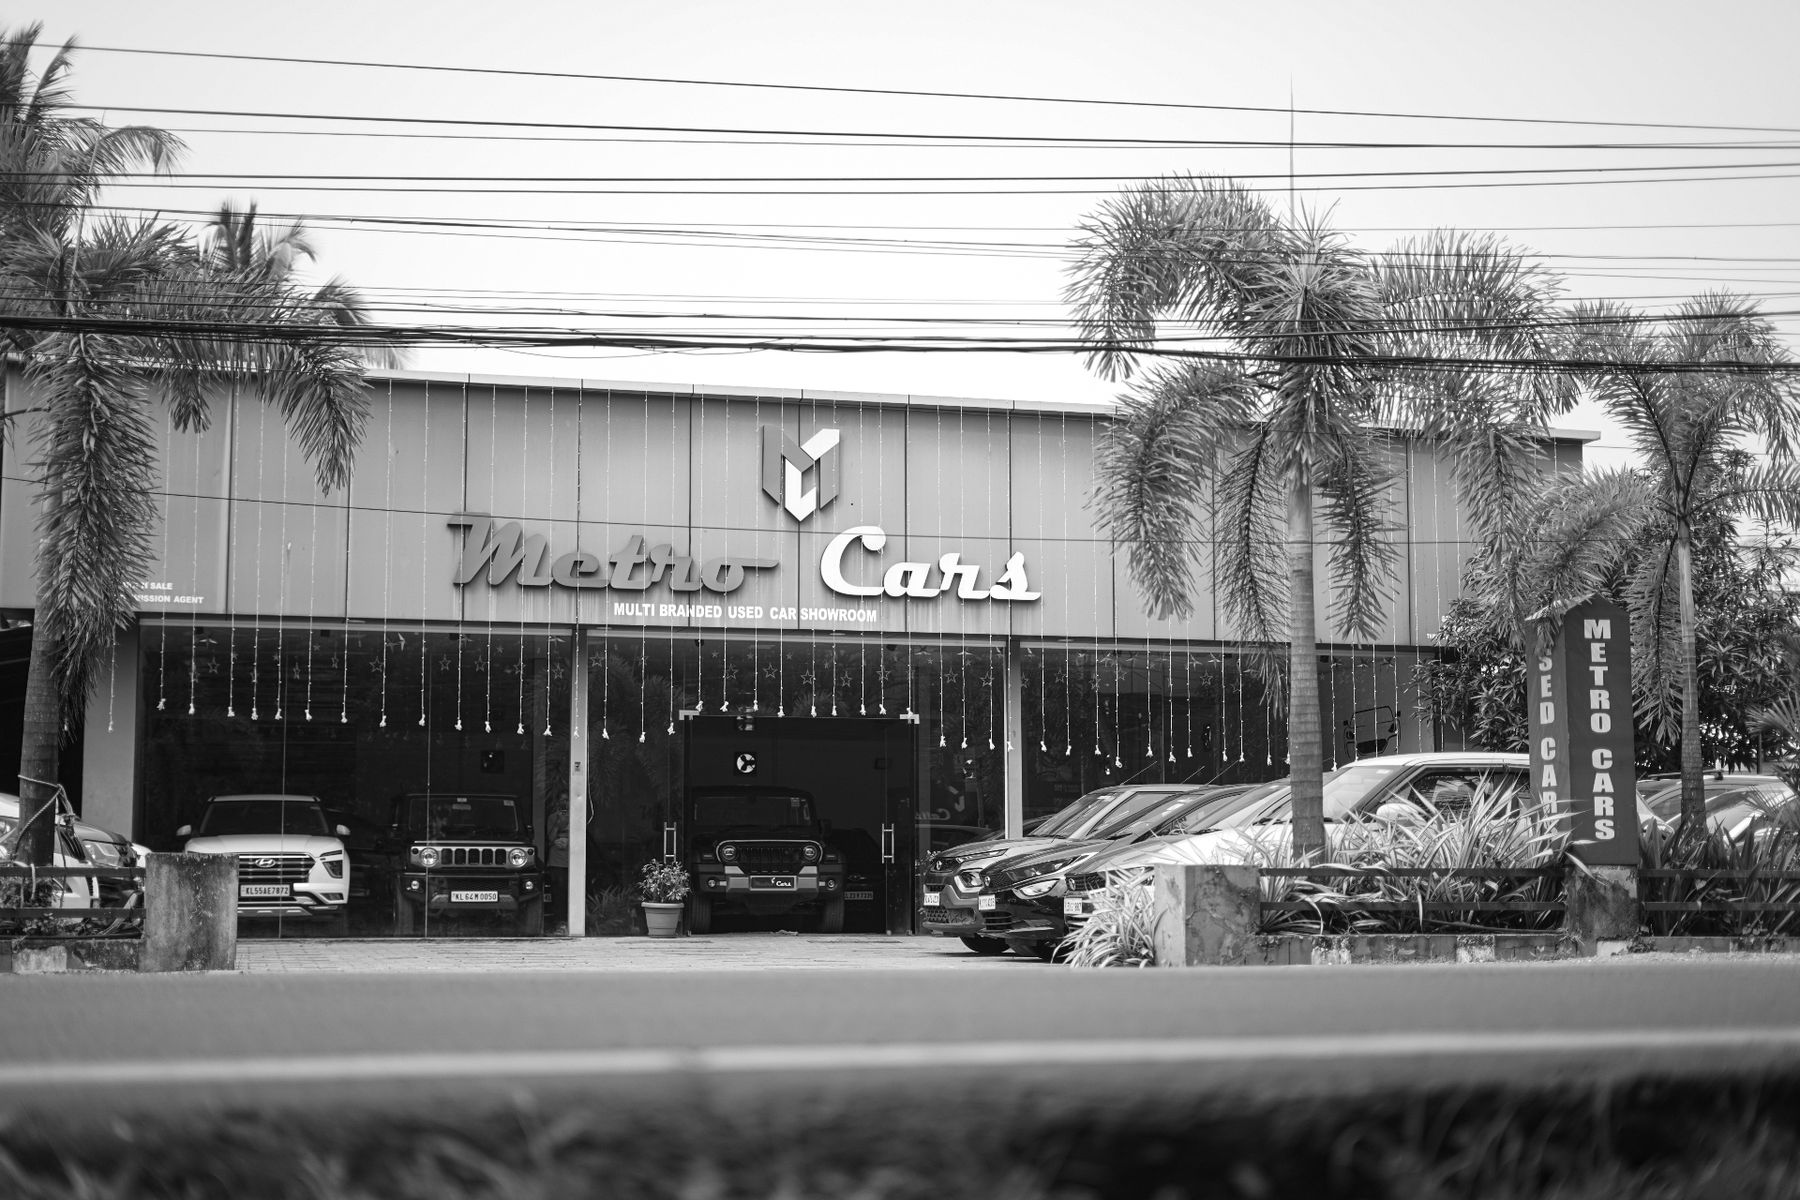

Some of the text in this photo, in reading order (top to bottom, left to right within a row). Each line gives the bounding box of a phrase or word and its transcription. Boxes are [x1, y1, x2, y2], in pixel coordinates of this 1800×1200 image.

[150, 582, 173, 590] SALE
[447, 511, 1041, 600] Metro Cars
[173, 595, 204, 604] AGENT
[614, 602, 877, 623] MULTI BRANDED USED CAR SHOWROOM
[1539, 648, 1556, 725] SED
[1583, 619, 1612, 733] METRO
[1540, 737, 1559, 815] CAR
[1591, 748, 1616, 840] CARS
